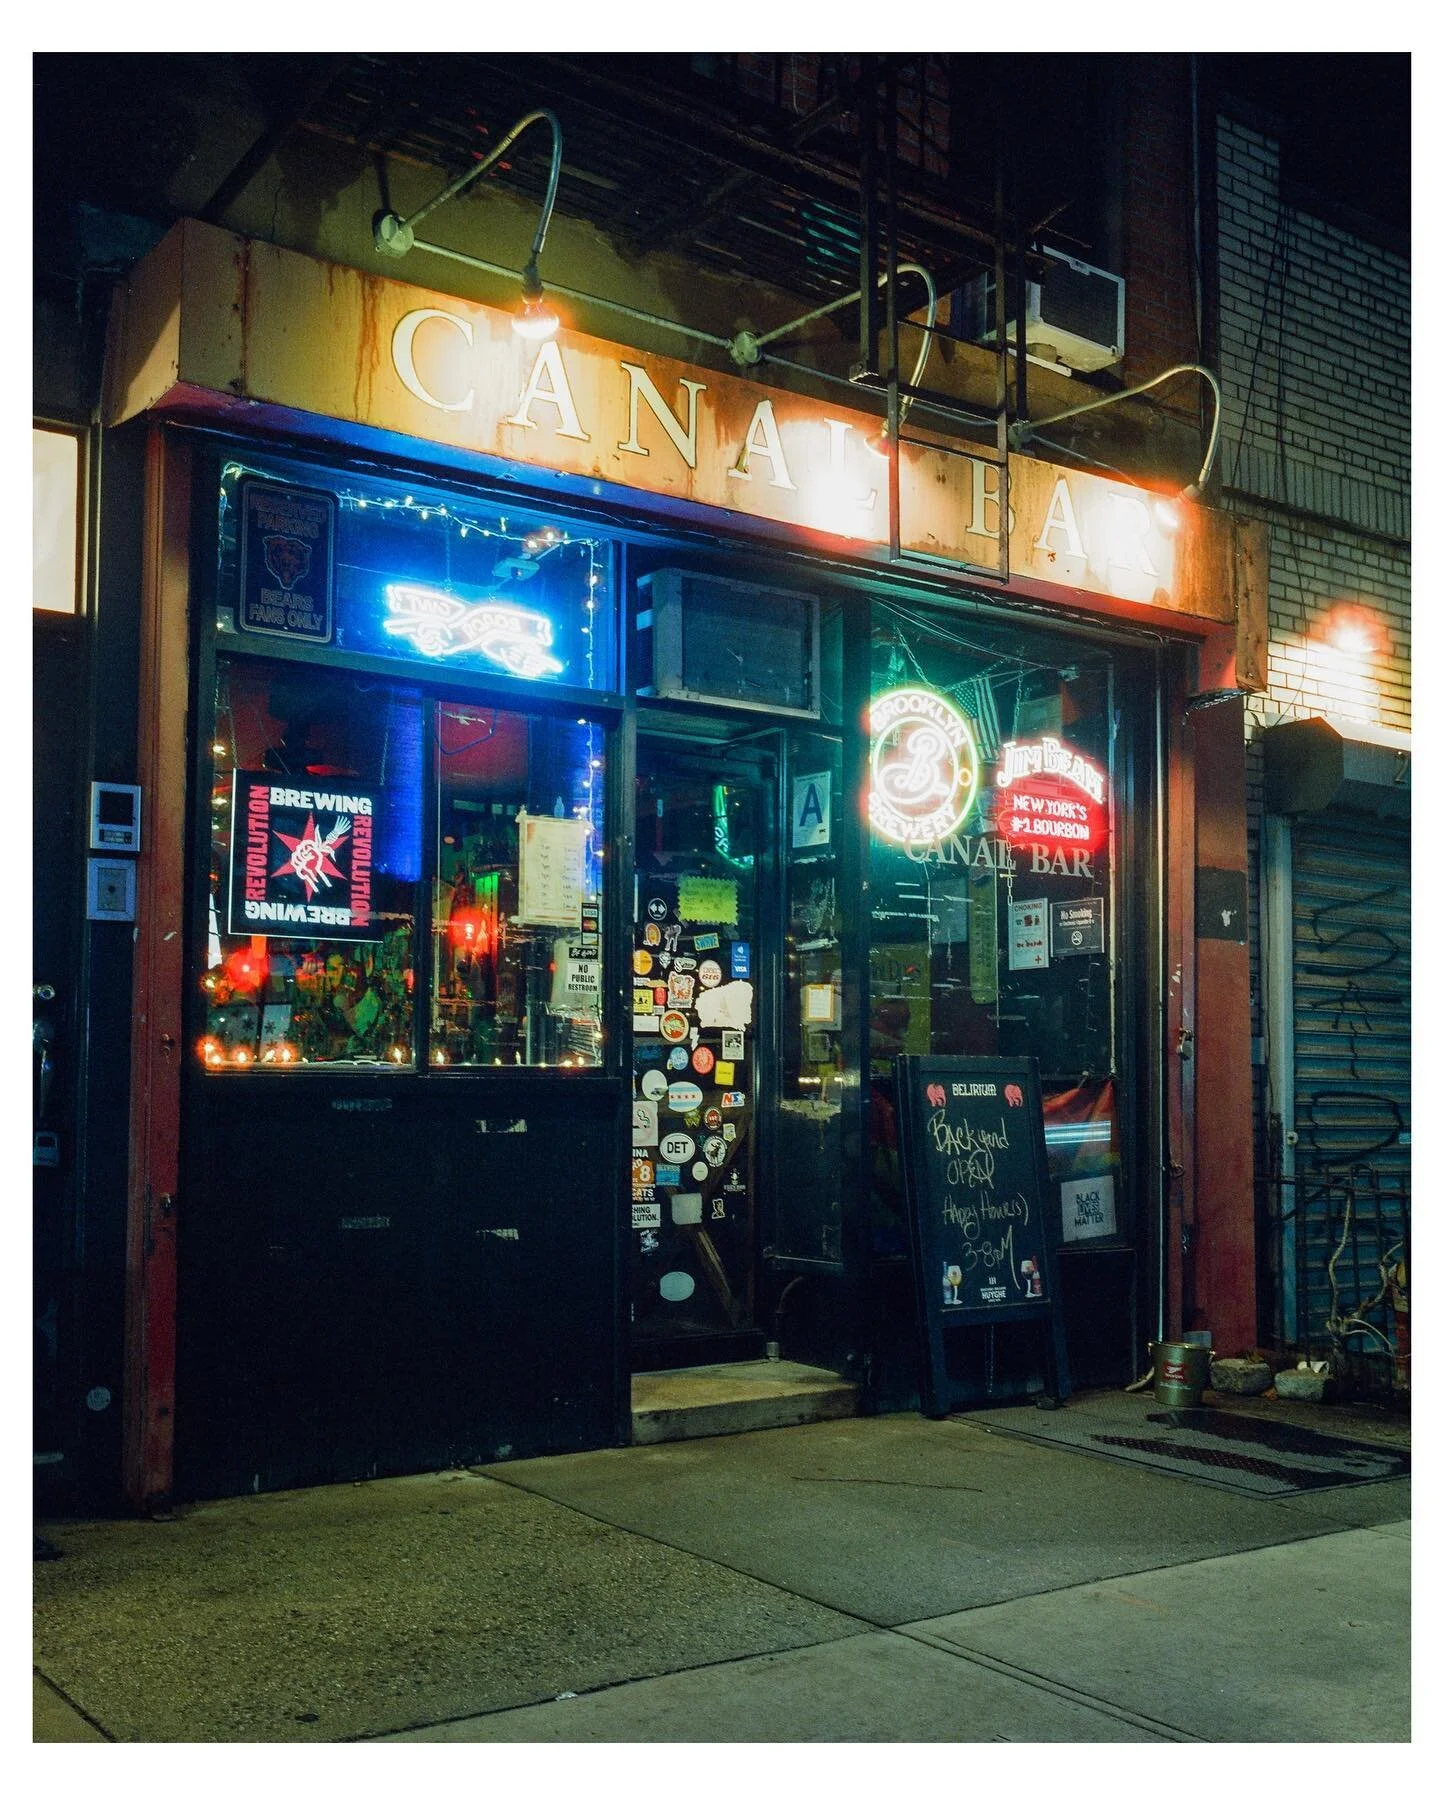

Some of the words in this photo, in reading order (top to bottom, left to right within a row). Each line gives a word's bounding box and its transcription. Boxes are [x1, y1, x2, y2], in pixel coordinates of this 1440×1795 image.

[391, 308, 878, 512] CANAL
[966, 458, 1160, 577] BAR
[257, 511, 320, 540] PARKING
[261, 588, 314, 612] BEARS
[249, 603, 286, 626] FANS
[287, 609, 324, 631] ONLY
[869, 693, 968, 748] BROOKLYN
[270, 786, 373, 816] BREWING
[800, 783, 823, 827] A
[1012, 794, 1044, 814] NEW
[1045, 799, 1088, 821] YORK'S
[868, 791, 958, 839] BREWERY
[1033, 818, 1090, 840] BOURBON
[245, 785, 270, 901] REVOLUTION
[904, 833, 1017, 870] CANAL
[1029, 842, 1095, 878] BAR
[351, 815, 373, 927] REVOLUTION
[245, 901, 351, 926] BREWING
[571, 974, 595, 983] PUBLIC
[578, 964, 589, 974] NO
[567, 983, 598, 992] RESTROOM
[952, 1083, 997, 1097] DELIRIUM
[666, 1141, 688, 1154] DET
[947, 1154, 994, 1189] OPEN
[1076, 1192, 1100, 1204] BLACK
[1074, 1211, 1104, 1227] MATTER
